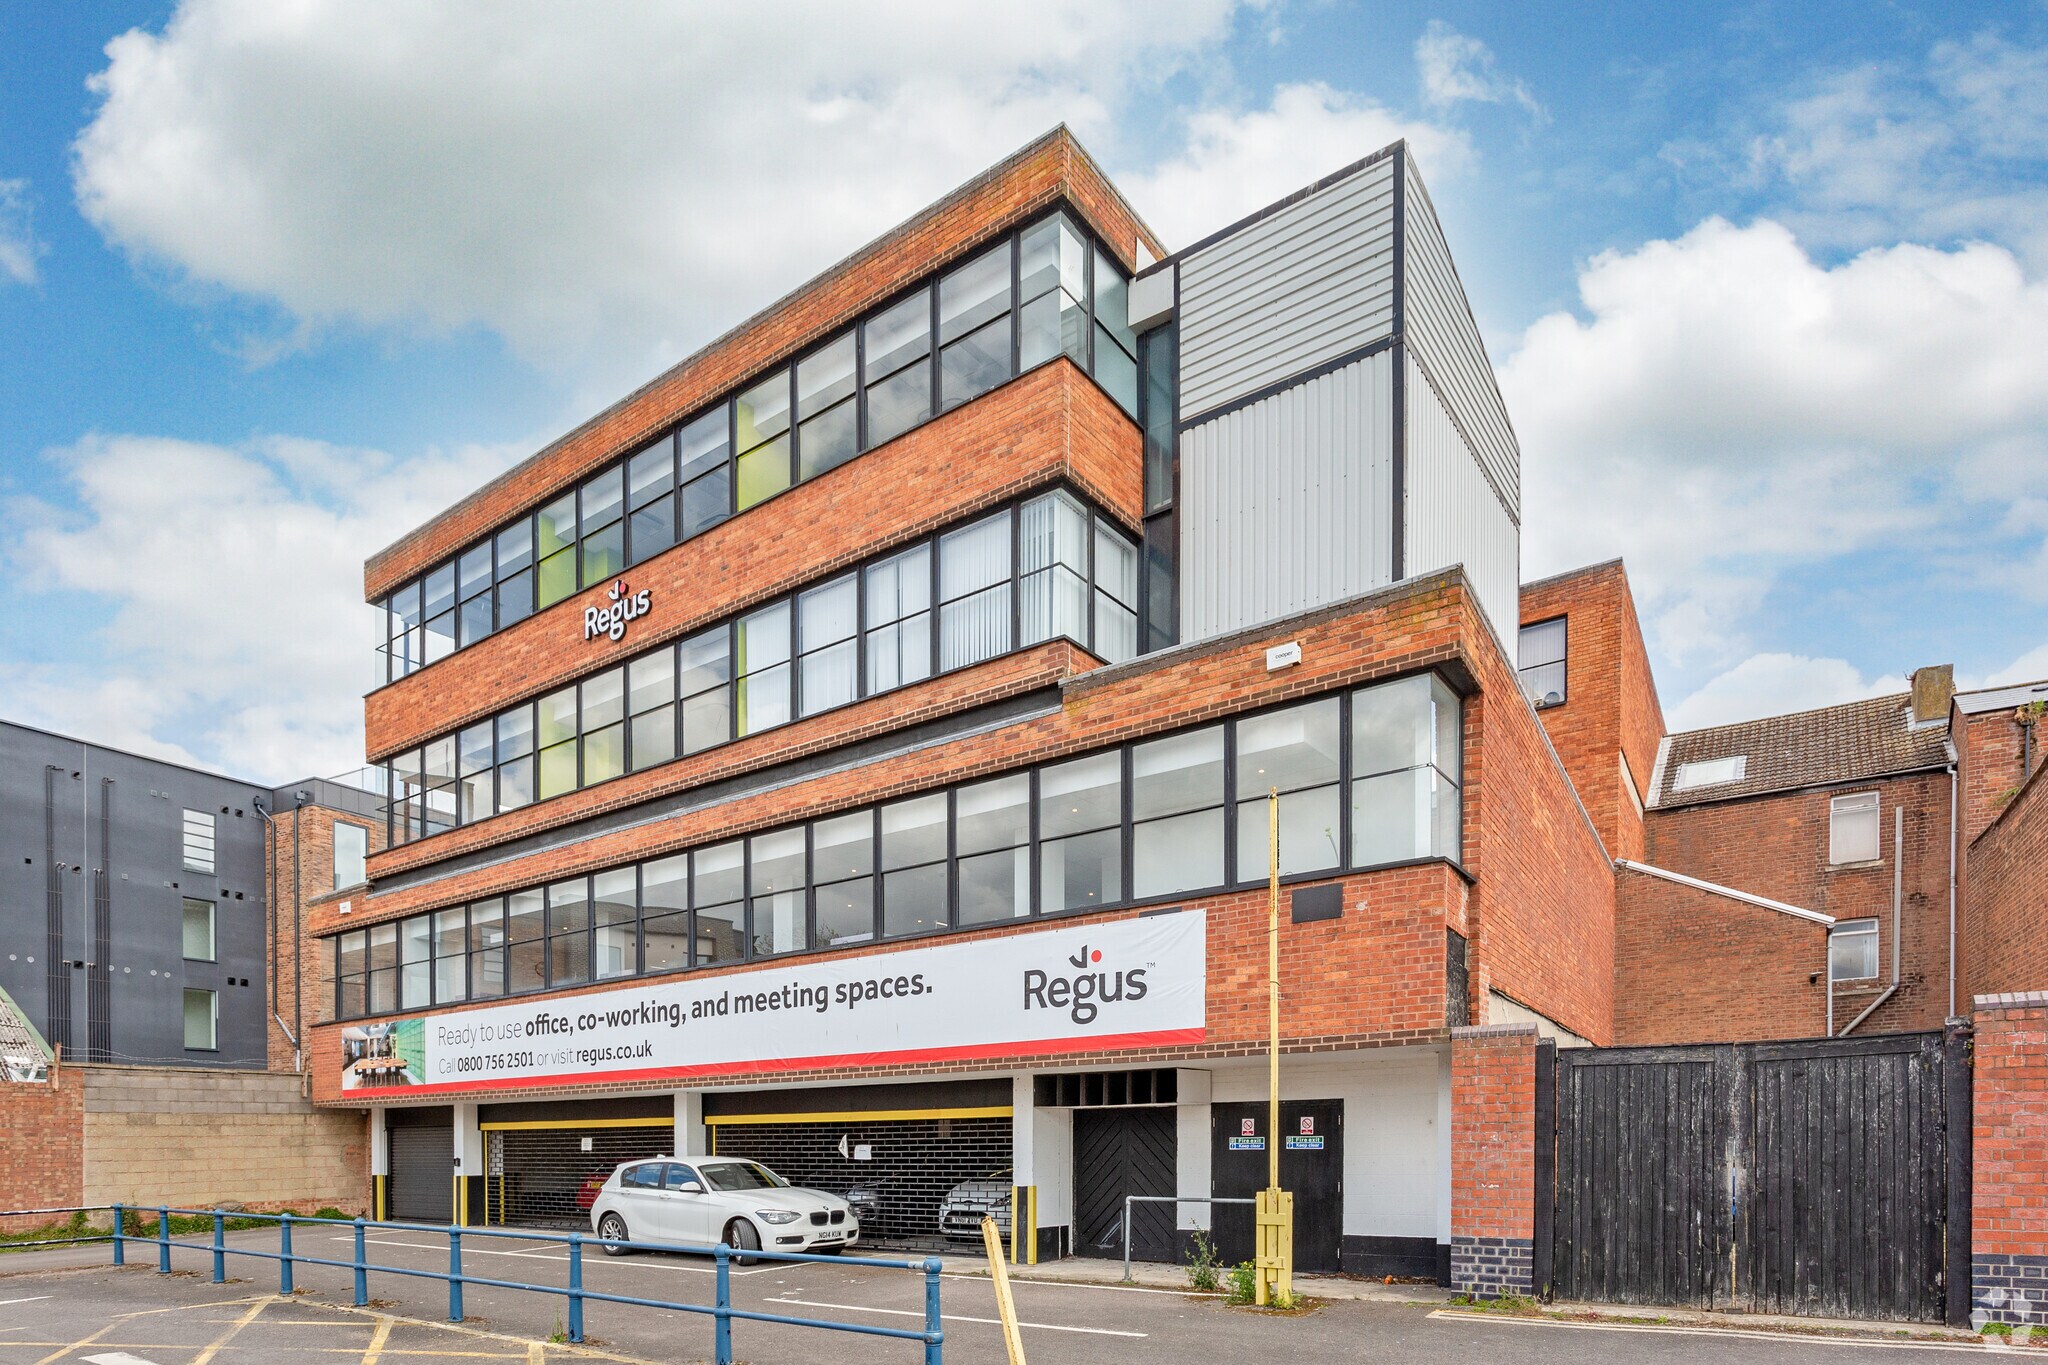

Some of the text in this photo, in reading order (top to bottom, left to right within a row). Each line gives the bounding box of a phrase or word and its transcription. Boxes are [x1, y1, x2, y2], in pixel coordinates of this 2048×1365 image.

[584, 589, 651, 641] Regus
[438, 973, 933, 1049] Ready to use office, co-working, and meeting spaces.
[1024, 968, 1148, 1025] Regus
[439, 1040, 653, 1074] Call 0800 756 2501 or visit regus.co.uk
